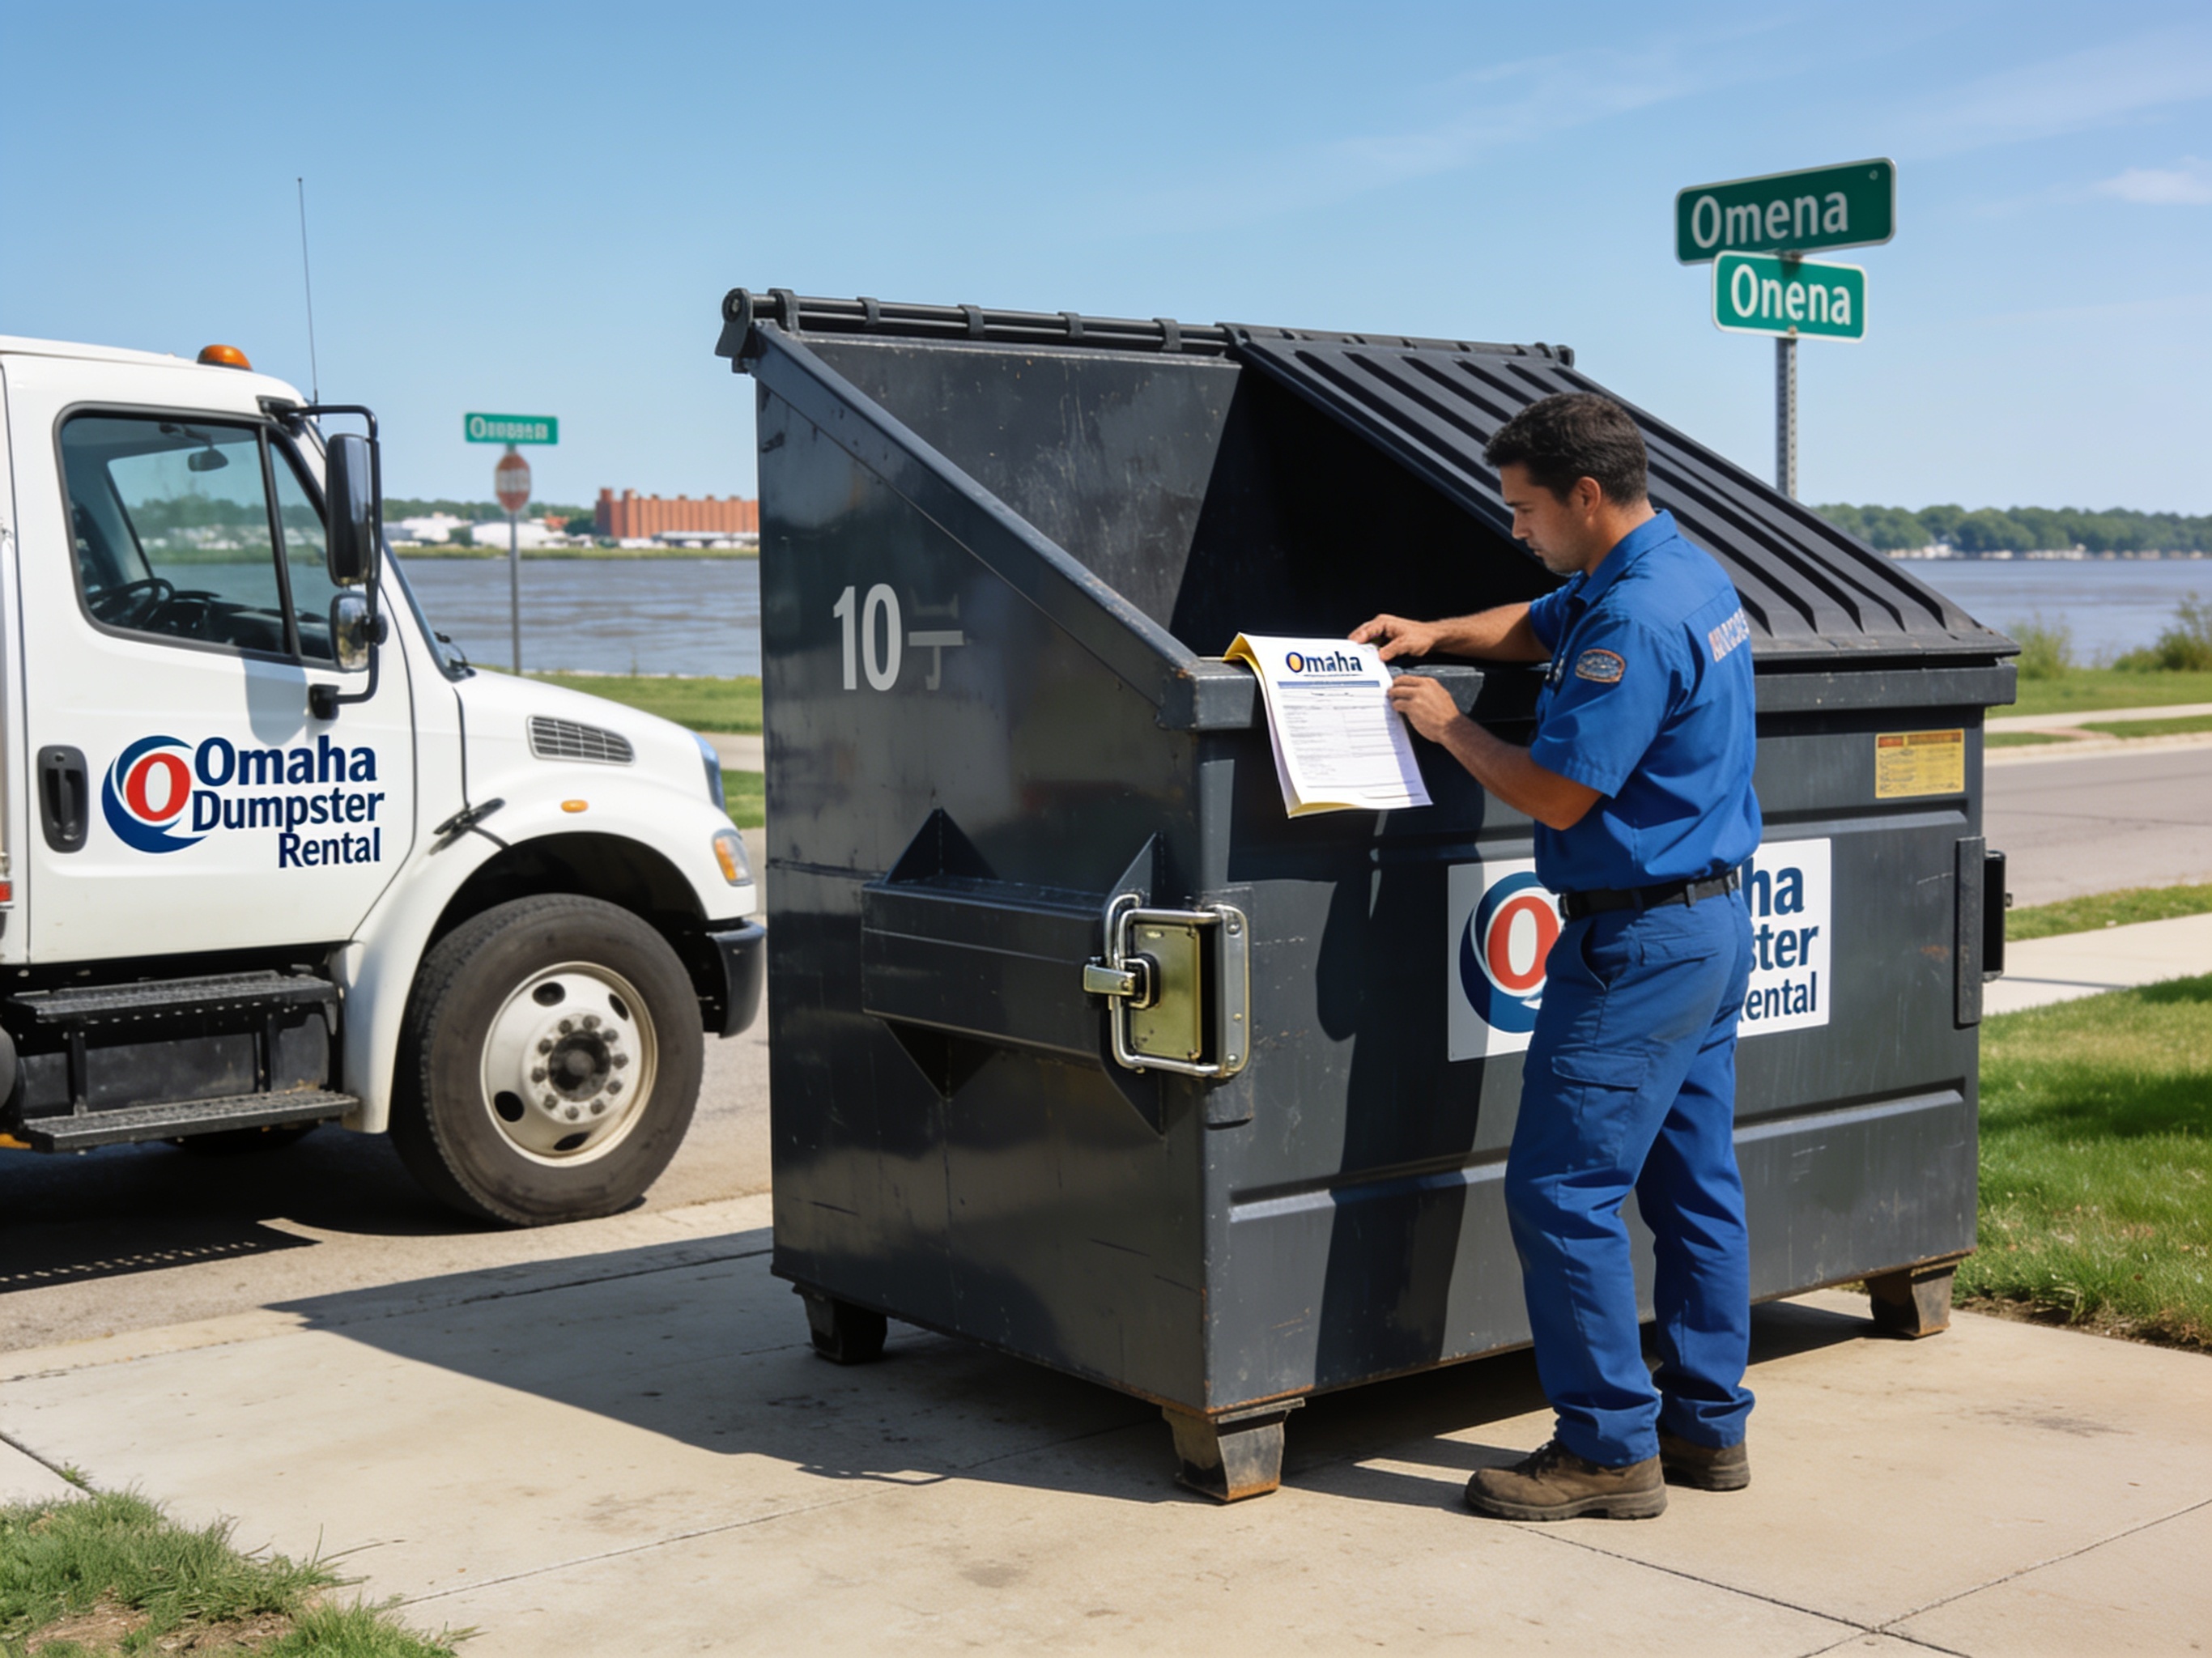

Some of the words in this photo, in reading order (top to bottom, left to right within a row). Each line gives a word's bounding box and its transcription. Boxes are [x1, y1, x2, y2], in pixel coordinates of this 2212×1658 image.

[1691, 192, 1848, 249] Omena
[1731, 264, 1851, 325] Onena
[833, 583, 902, 691] 10
[1286, 651, 1363, 673] Omaha
[194, 735, 377, 787] Omaha
[193, 788, 385, 832] Dumpster
[279, 827, 381, 868] Rental
[1740, 971, 1817, 1022] ental
